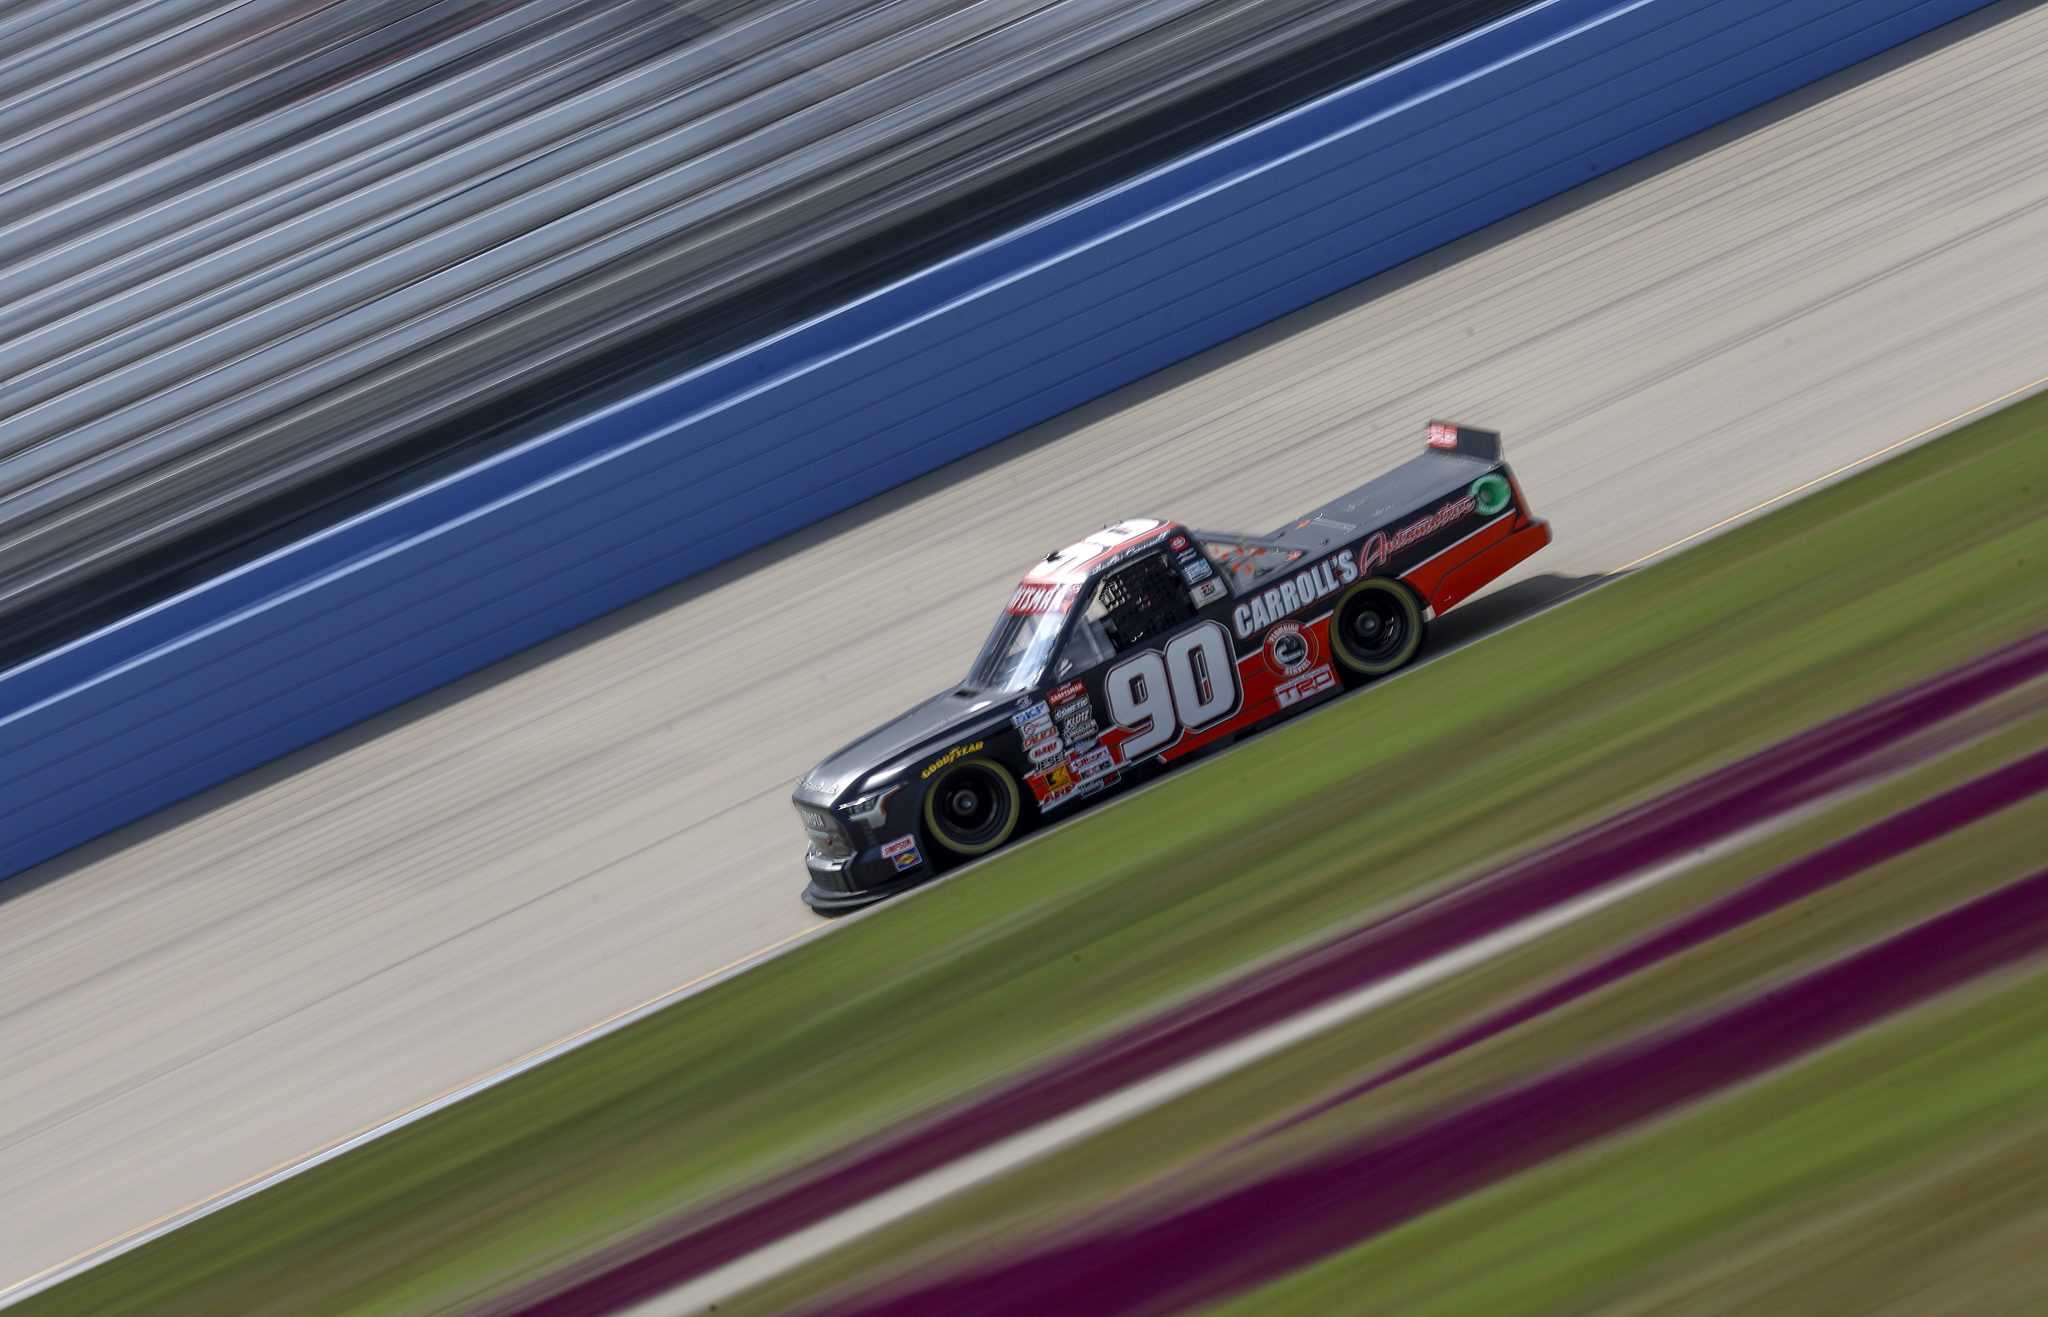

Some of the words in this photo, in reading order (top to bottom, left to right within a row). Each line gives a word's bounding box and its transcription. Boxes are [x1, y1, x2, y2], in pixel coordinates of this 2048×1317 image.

[1360, 494, 1476, 576] Automotive
[1233, 549, 1359, 640] CARROLL'S
[1269, 622, 1300, 645] PLUMBING
[1279, 671, 1336, 703] TRD
[1284, 658, 1312, 677] SERVICE
[1105, 619, 1244, 766] 90
[920, 740, 984, 779] GOODYEAR
